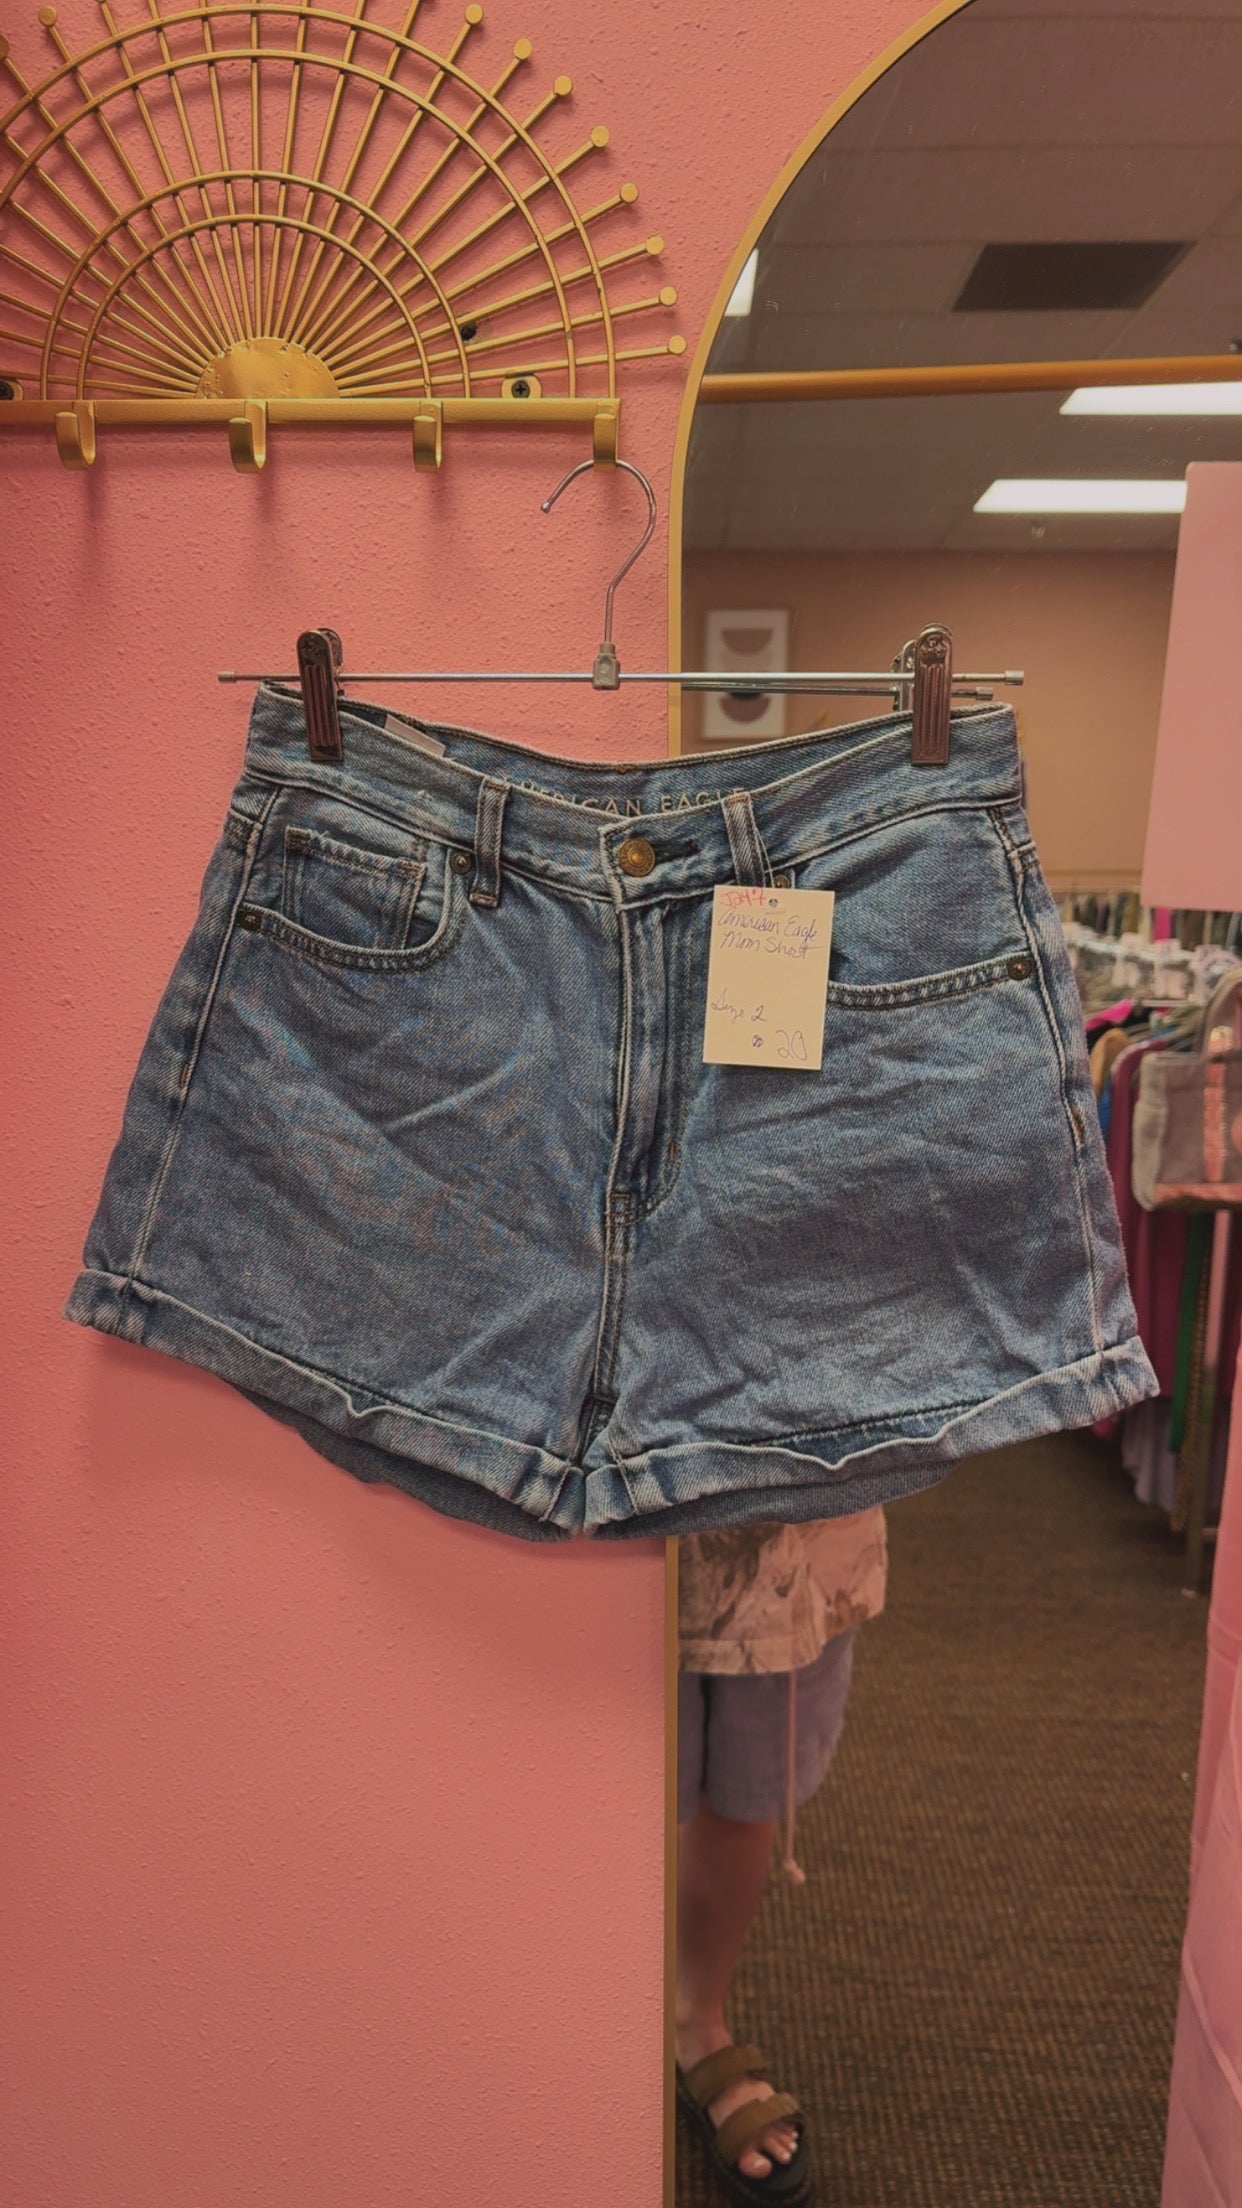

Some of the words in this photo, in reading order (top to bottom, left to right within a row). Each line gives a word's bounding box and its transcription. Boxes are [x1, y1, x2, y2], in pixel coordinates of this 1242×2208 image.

[521, 782, 641, 816] ICAN
[720, 931, 761, 952] Mom
[783, 915, 818, 943] Eagle
[710, 986, 745, 1026] Size
[750, 1004, 768, 1022] 2
[770, 1028, 808, 1061] 20
